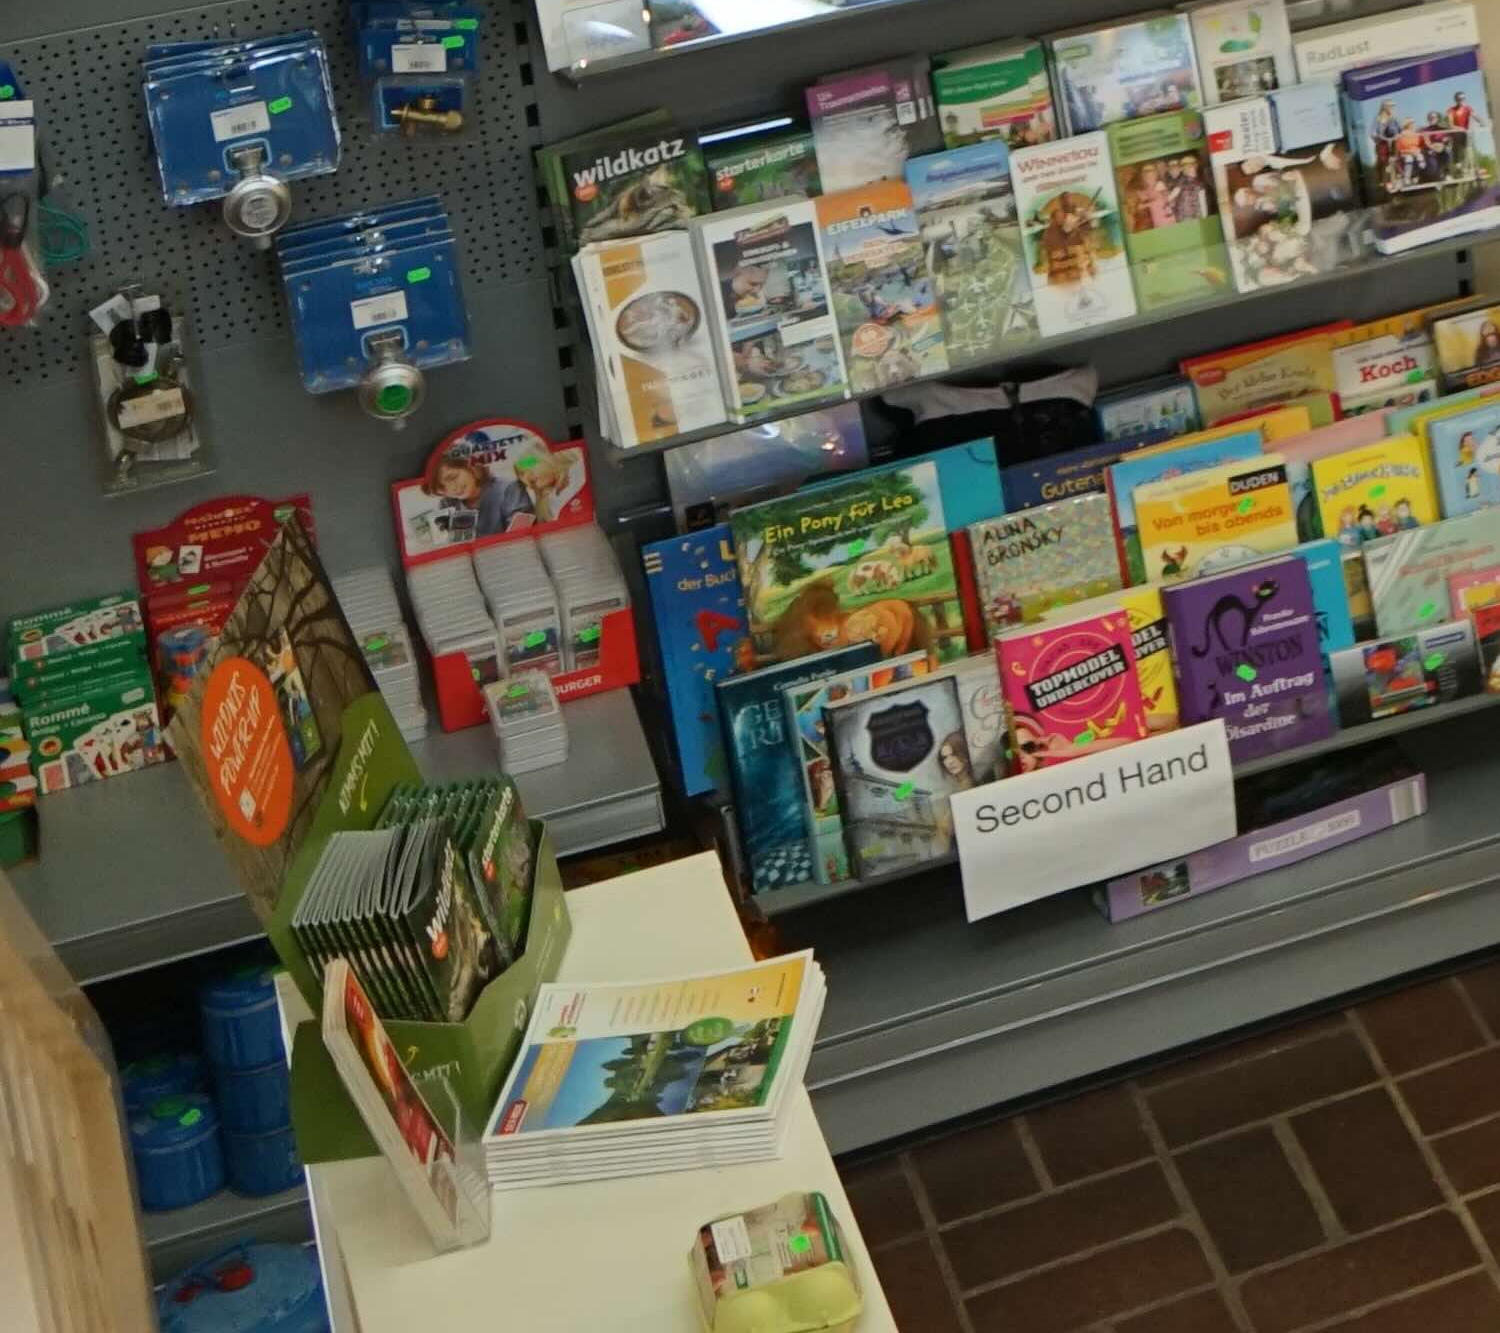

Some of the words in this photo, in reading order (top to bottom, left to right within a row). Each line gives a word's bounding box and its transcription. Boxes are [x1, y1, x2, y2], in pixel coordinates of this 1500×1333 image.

[1305, 39, 1371, 64] RadLust
[573, 137, 687, 189] wildkatz
[1359, 355, 1419, 384] Koch
[468, 448, 509, 468] MIX
[1230, 470, 1281, 494] DUDEN
[764, 526, 795, 544] Ein
[800, 513, 843, 534] Pony
[848, 500, 875, 520] für
[1152, 513, 1184, 532] Von
[1196, 520, 1221, 538] bis
[1224, 505, 1284, 531] abends
[986, 525, 1065, 567] BRONSKY
[1028, 647, 1123, 697] TOPMODEL
[1223, 687, 1247, 706] Im
[1250, 671, 1315, 699] Auftrag
[29, 702, 92, 730] Rommé
[1242, 701, 1271, 719] der
[974, 775, 1107, 836] Second
[1119, 743, 1211, 794] Hand
